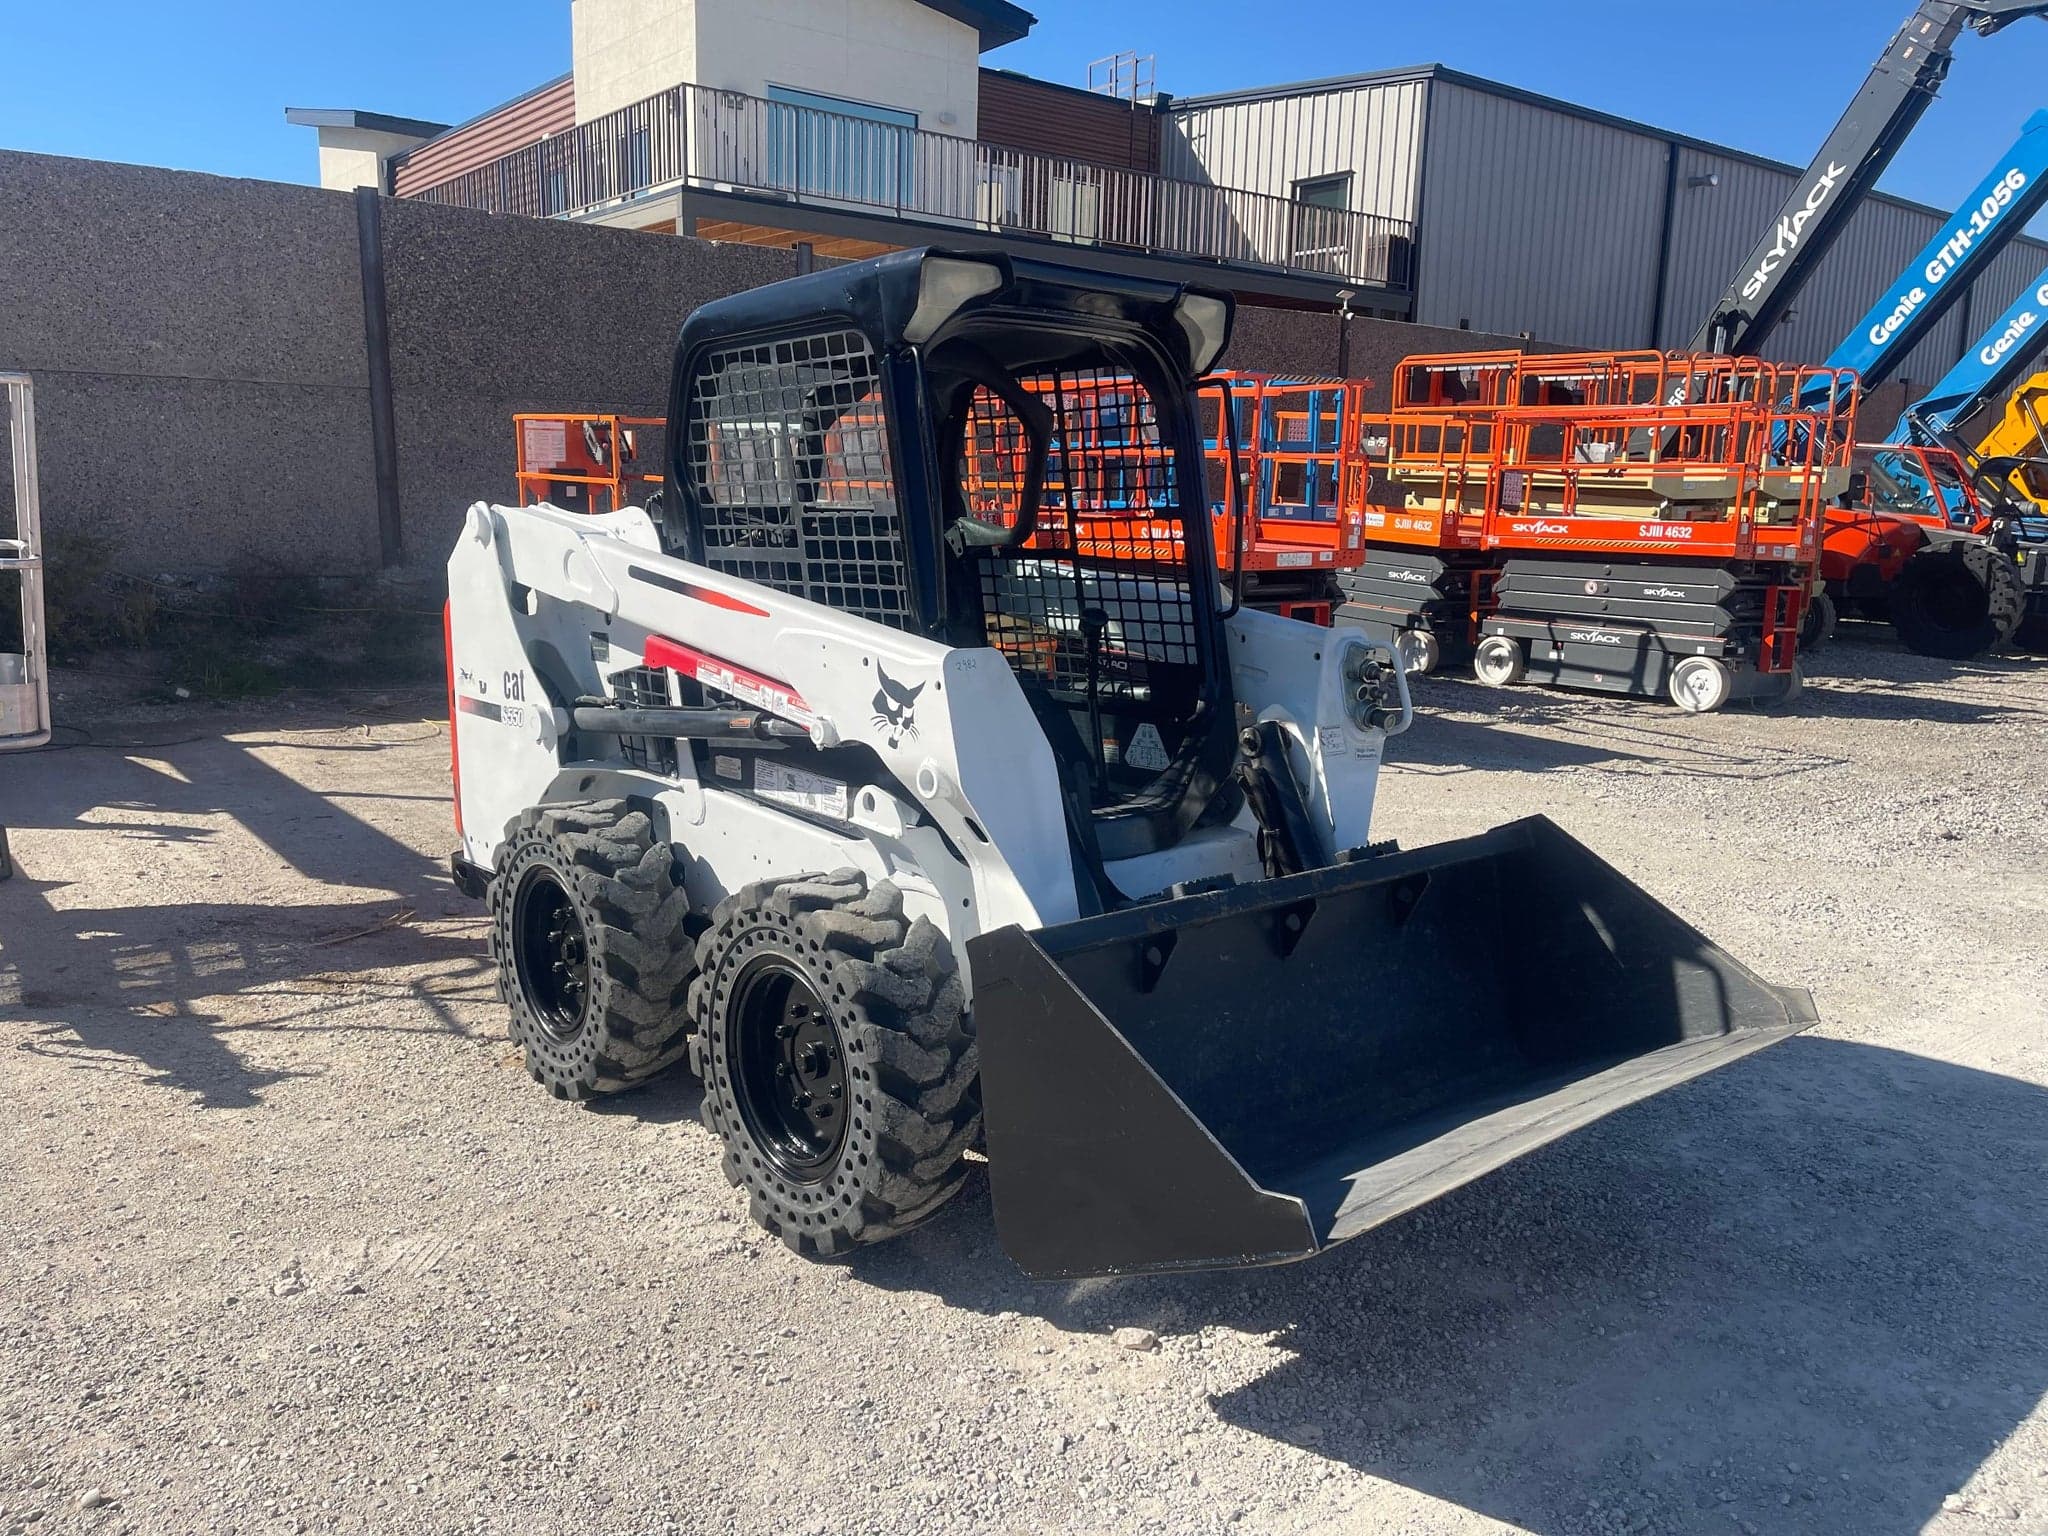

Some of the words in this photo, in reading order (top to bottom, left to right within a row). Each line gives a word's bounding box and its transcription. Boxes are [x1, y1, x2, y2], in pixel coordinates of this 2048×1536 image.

[1742, 160, 1847, 300] SKYJACK
[1869, 286, 1926, 346] Genie
[1925, 168, 2027, 285] GTH-1056
[1980, 311, 2038, 366] Genie
[1413, 520, 1433, 532] 4632
[1511, 519, 1569, 534] SKYJACK
[1664, 526, 1692, 539] 4632
[1387, 570, 1427, 582] SKYJACK
[1643, 586, 1686, 599] SKYJACK
[1569, 630, 1622, 645] SKYJACK
